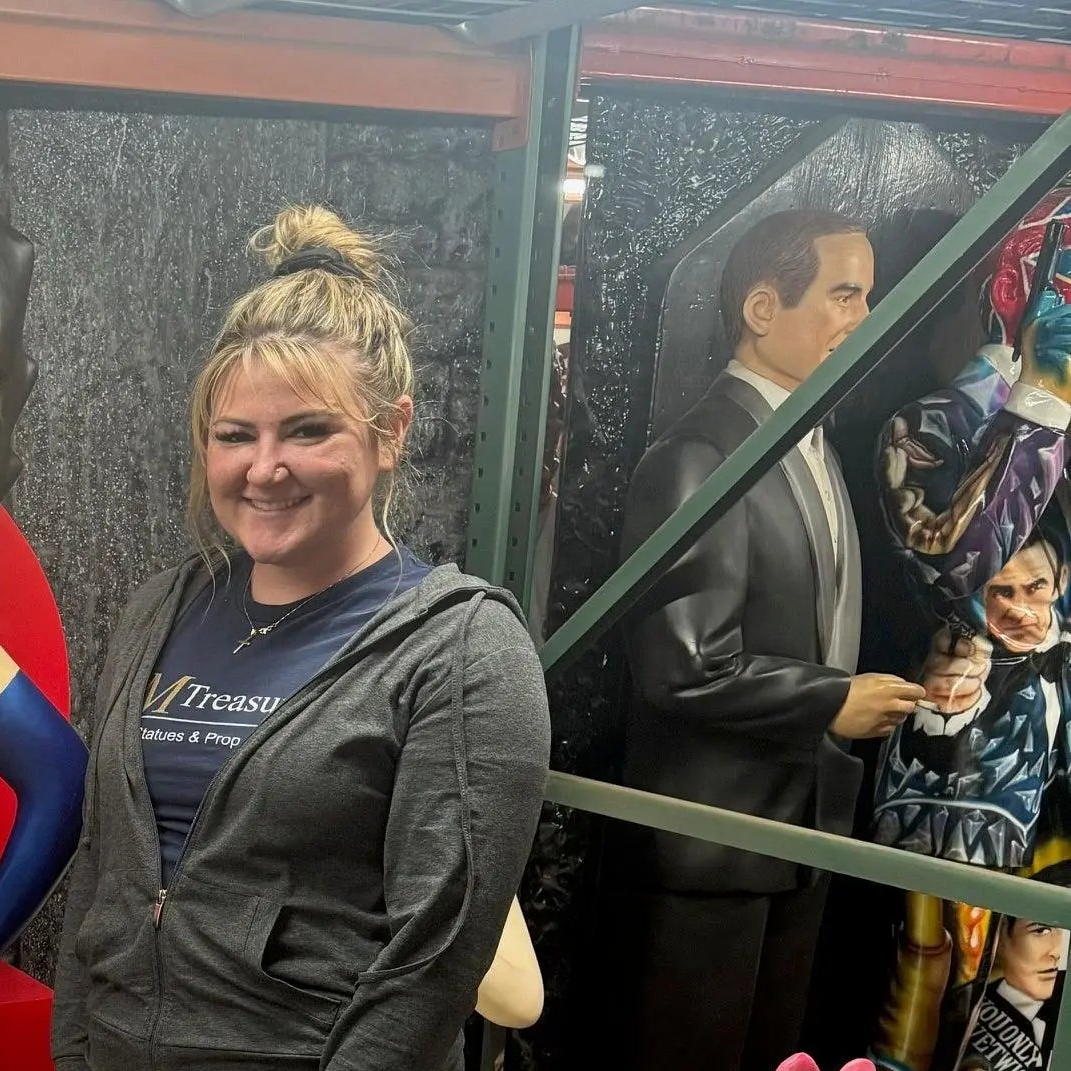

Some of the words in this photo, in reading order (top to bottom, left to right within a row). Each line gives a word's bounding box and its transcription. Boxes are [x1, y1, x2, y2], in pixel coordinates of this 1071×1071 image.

[180, 683, 283, 713] Treasu
[140, 726, 184, 742] tatues
[188, 731, 200, 743] &
[205, 732, 240, 749] Prop
[979, 997, 1013, 1030] YOU
[999, 1026, 1042, 1068] ONLY
